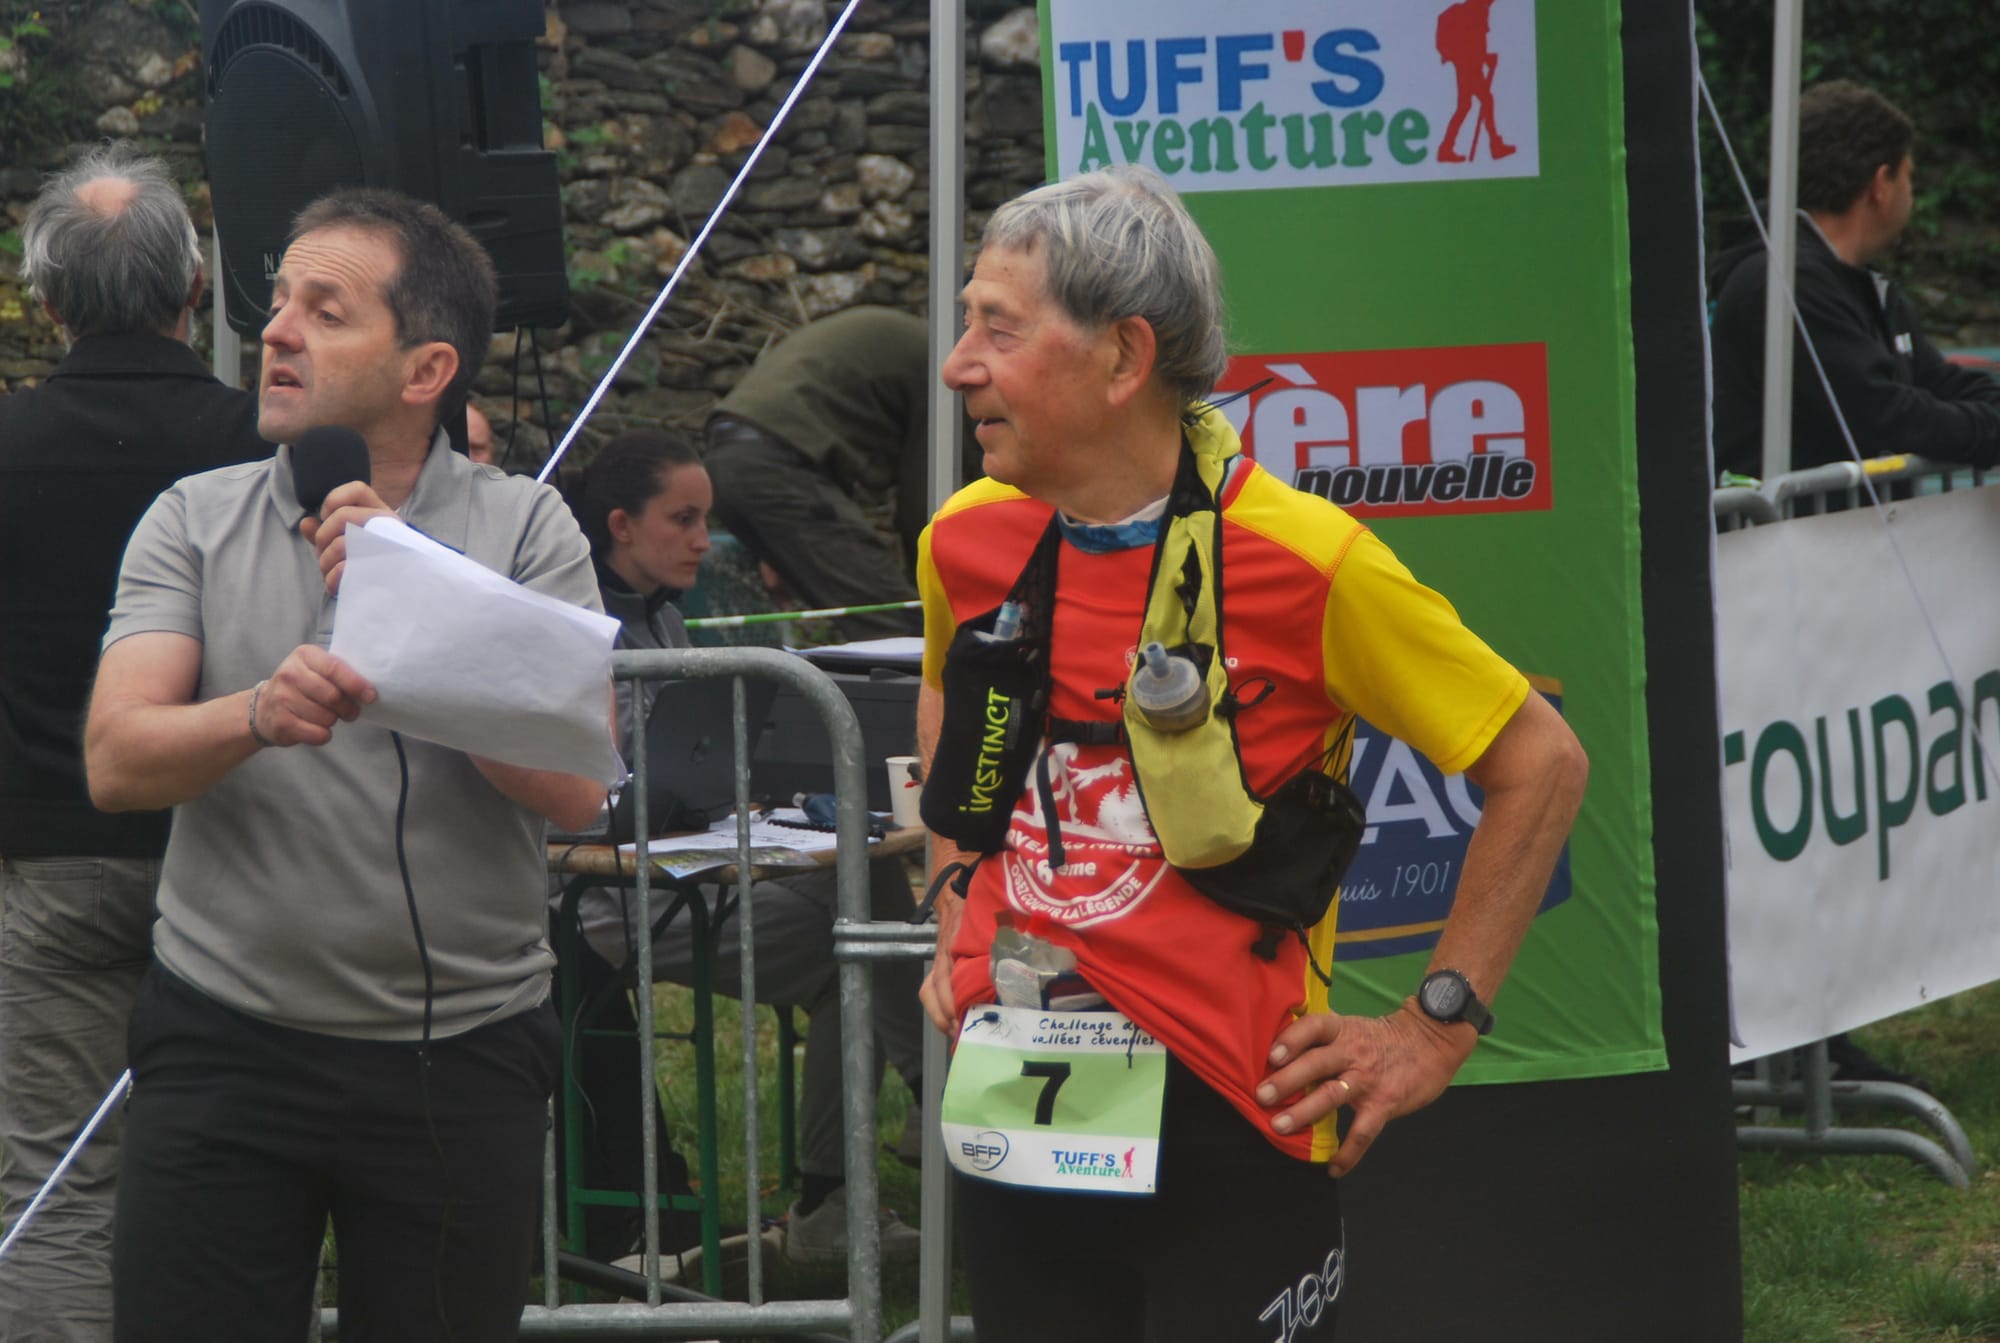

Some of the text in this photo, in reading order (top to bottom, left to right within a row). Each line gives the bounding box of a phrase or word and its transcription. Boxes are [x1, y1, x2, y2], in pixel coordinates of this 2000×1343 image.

[1060, 28, 1385, 117] TUFF'S
[1079, 101, 1430, 174] Aventure
[1294, 453, 1534, 506] nouvelle
[1391, 860, 1450, 898] 1901
[1032, 1032, 1081, 1045] vallées
[1039, 1018, 1112, 1034] Challenge
[1020, 1060, 1071, 1126] 7
[962, 1142, 1001, 1160] BFP
[1052, 1150, 1116, 1168] TUFF'S
[1056, 1161, 1122, 1178] Aventure
